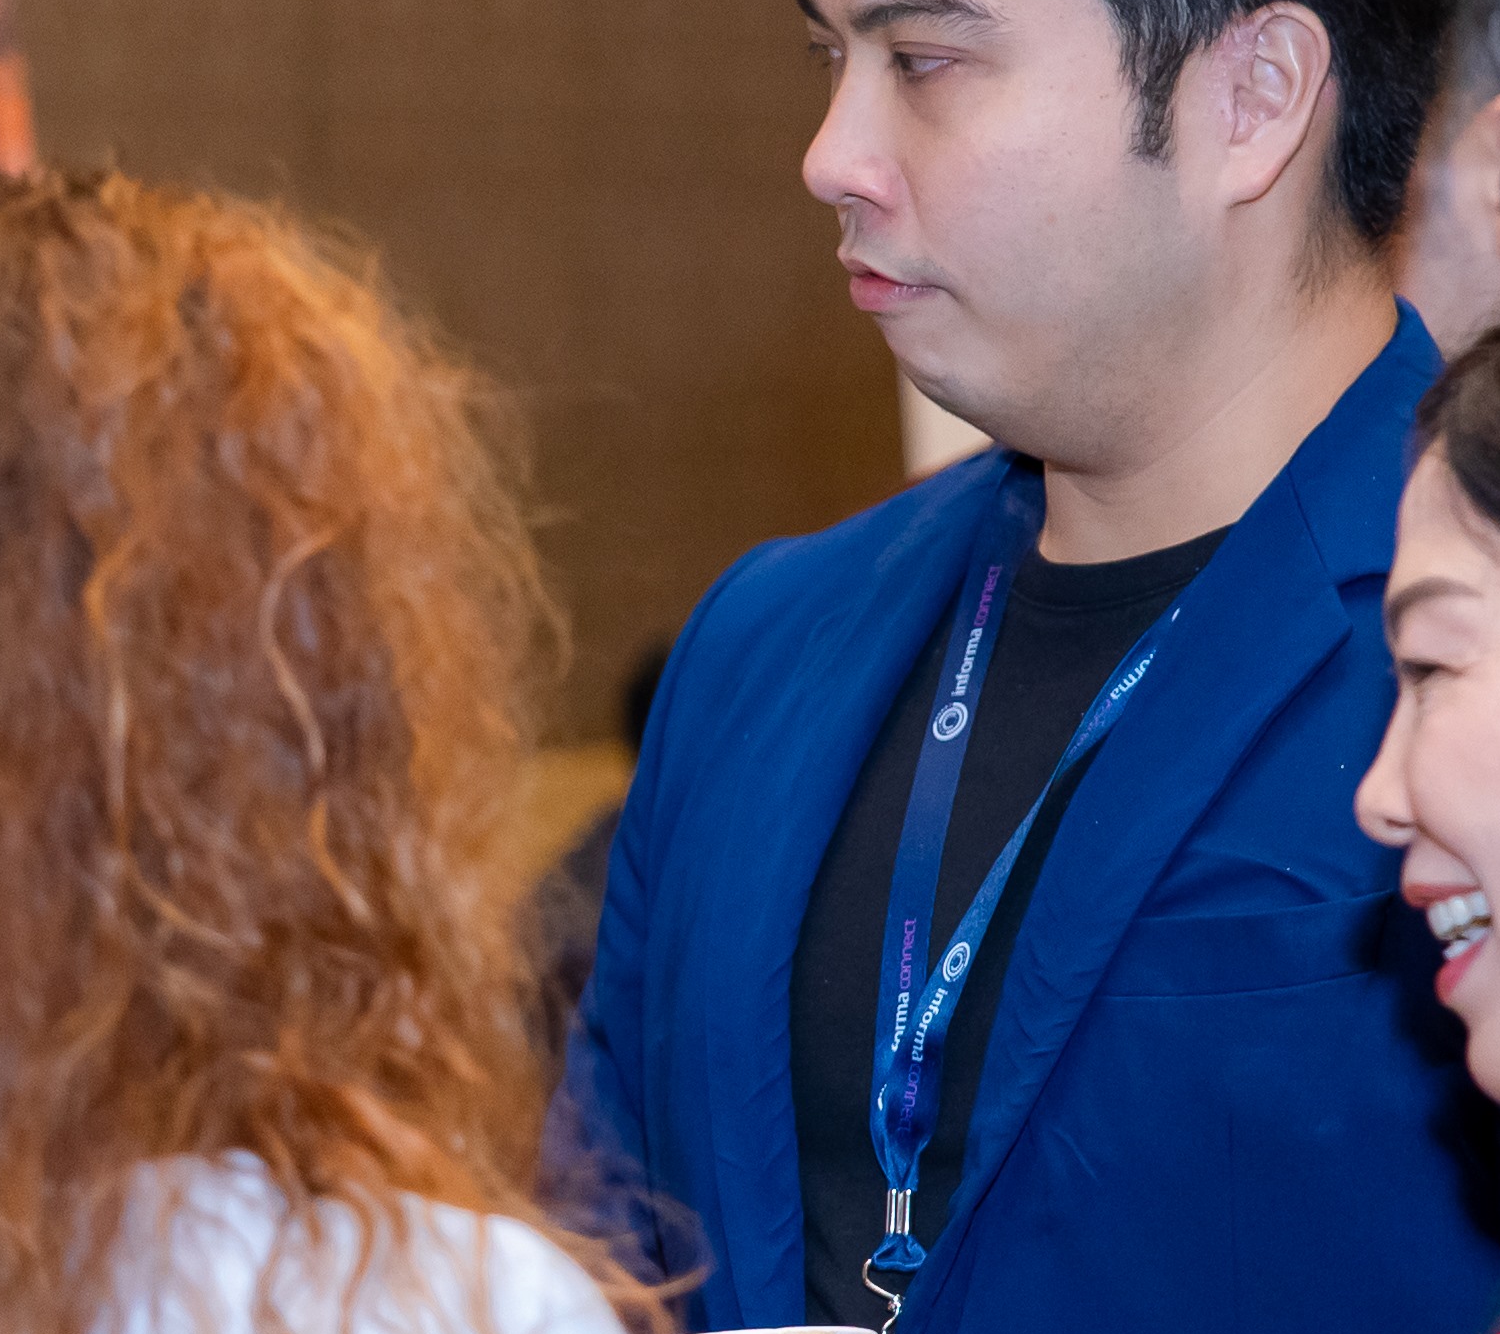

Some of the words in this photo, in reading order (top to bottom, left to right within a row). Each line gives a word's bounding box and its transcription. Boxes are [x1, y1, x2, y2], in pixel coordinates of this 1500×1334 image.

[951, 627, 983, 697] informa
[899, 918, 917, 990] connect
[911, 987, 949, 1063] informa
